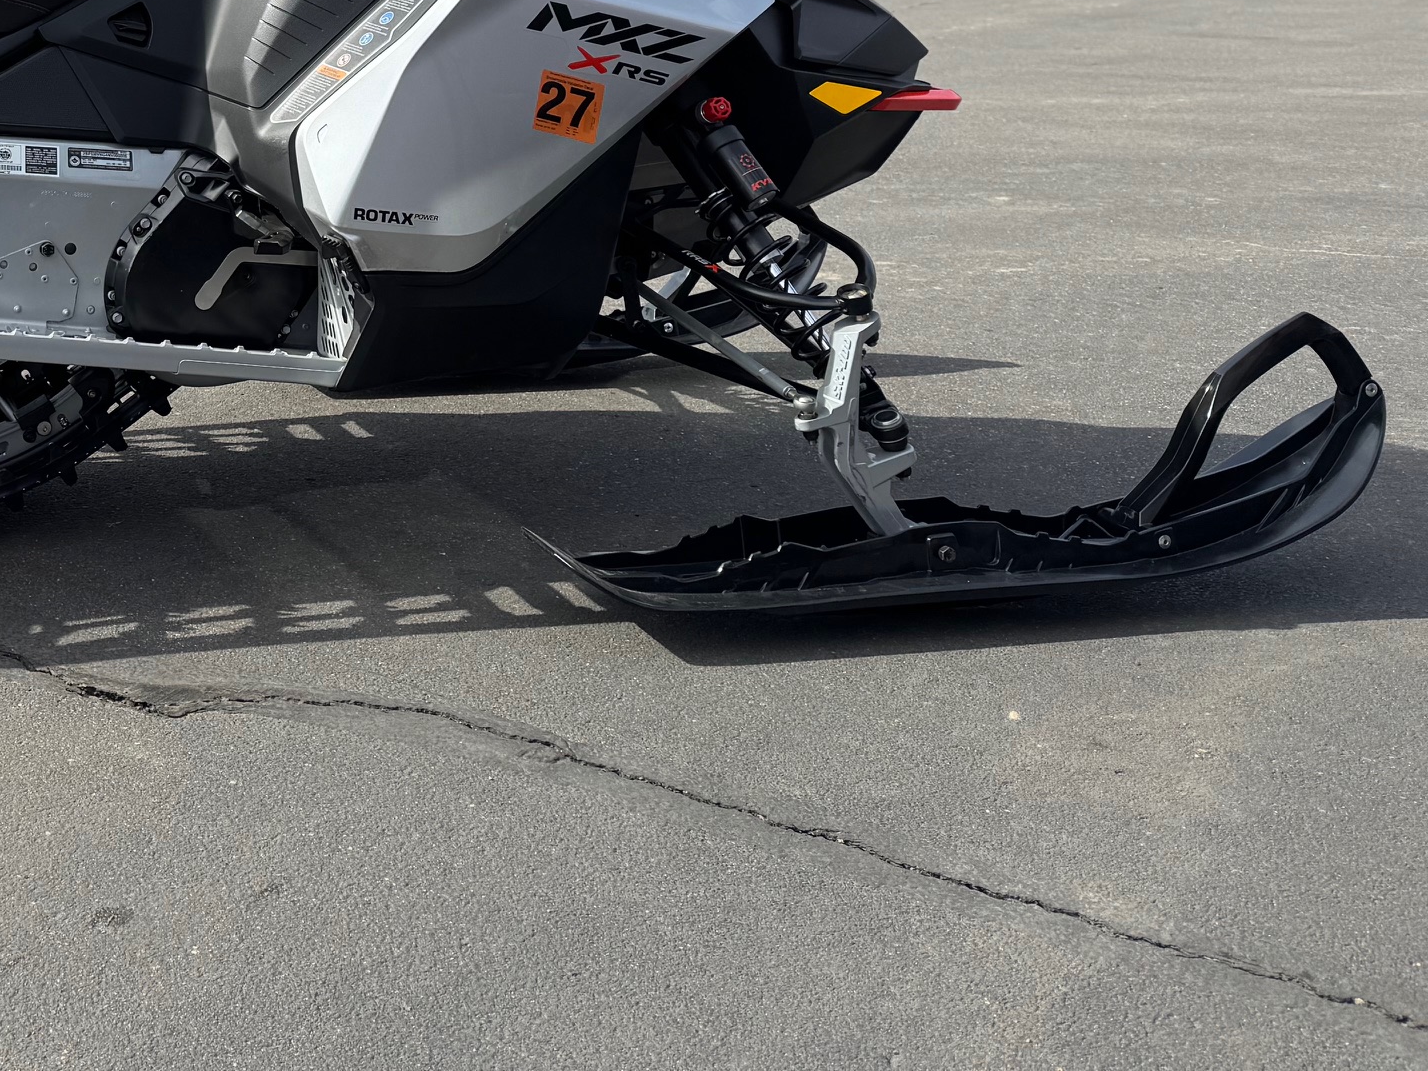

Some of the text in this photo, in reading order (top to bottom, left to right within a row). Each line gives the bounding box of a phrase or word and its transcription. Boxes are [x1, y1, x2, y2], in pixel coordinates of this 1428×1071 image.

[526, 1, 707, 65] MXZ
[536, 80, 595, 128] 27
[353, 207, 439, 226] ROTAX POWER
